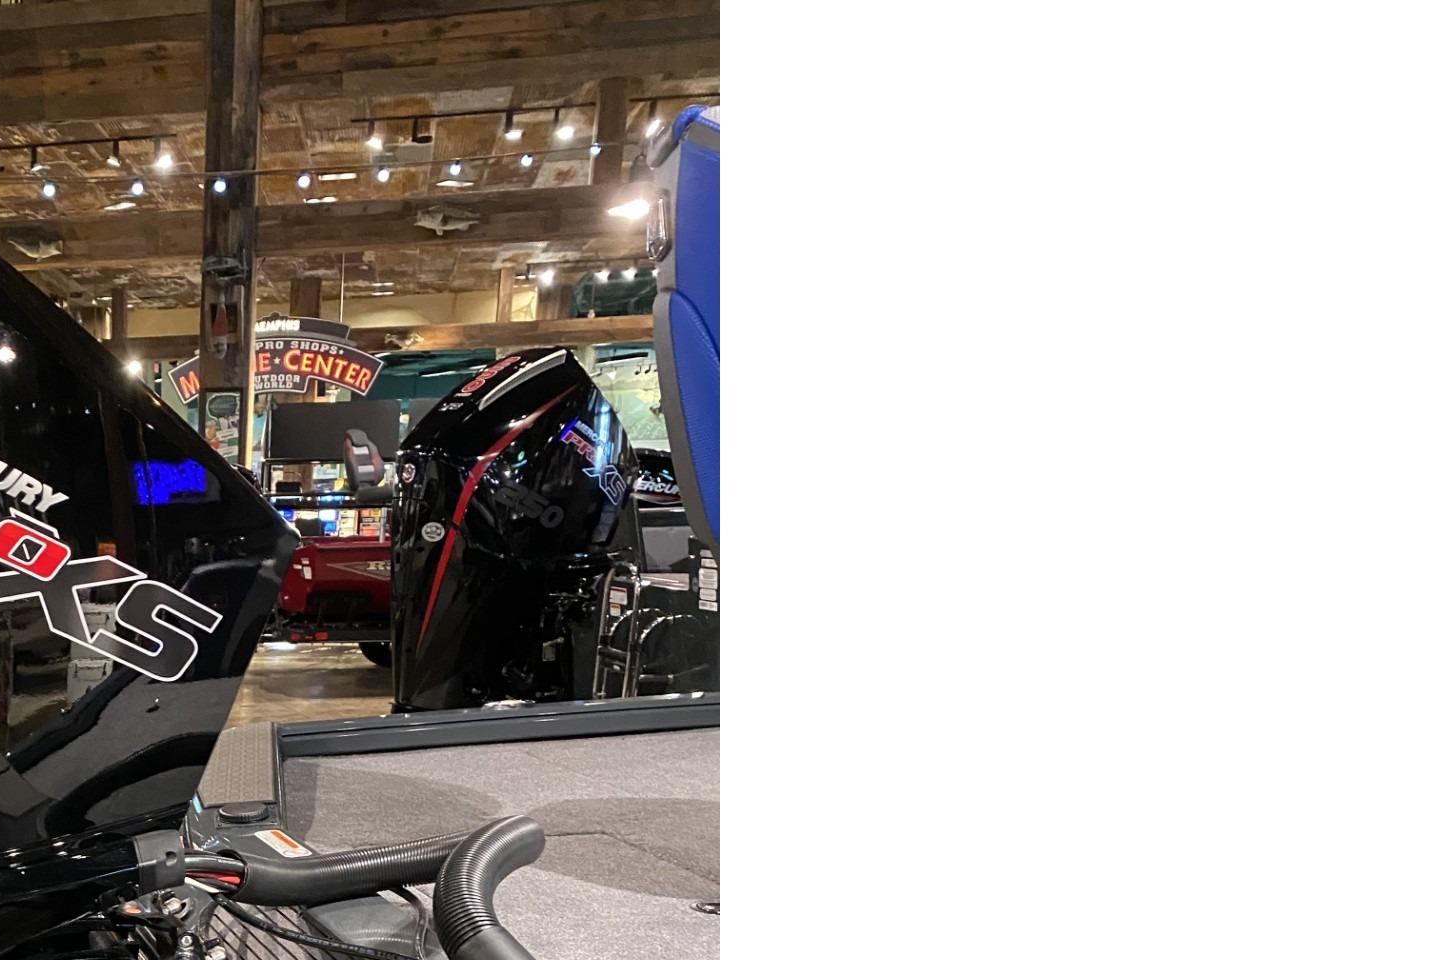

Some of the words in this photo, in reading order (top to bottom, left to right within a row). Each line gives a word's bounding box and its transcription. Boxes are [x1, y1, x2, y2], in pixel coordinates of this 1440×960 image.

[256, 341, 284, 350] PRO
[290, 340, 338, 355] SHOPS
[283, 349, 372, 391] CENTER
[255, 374, 300, 383] UTDOOR
